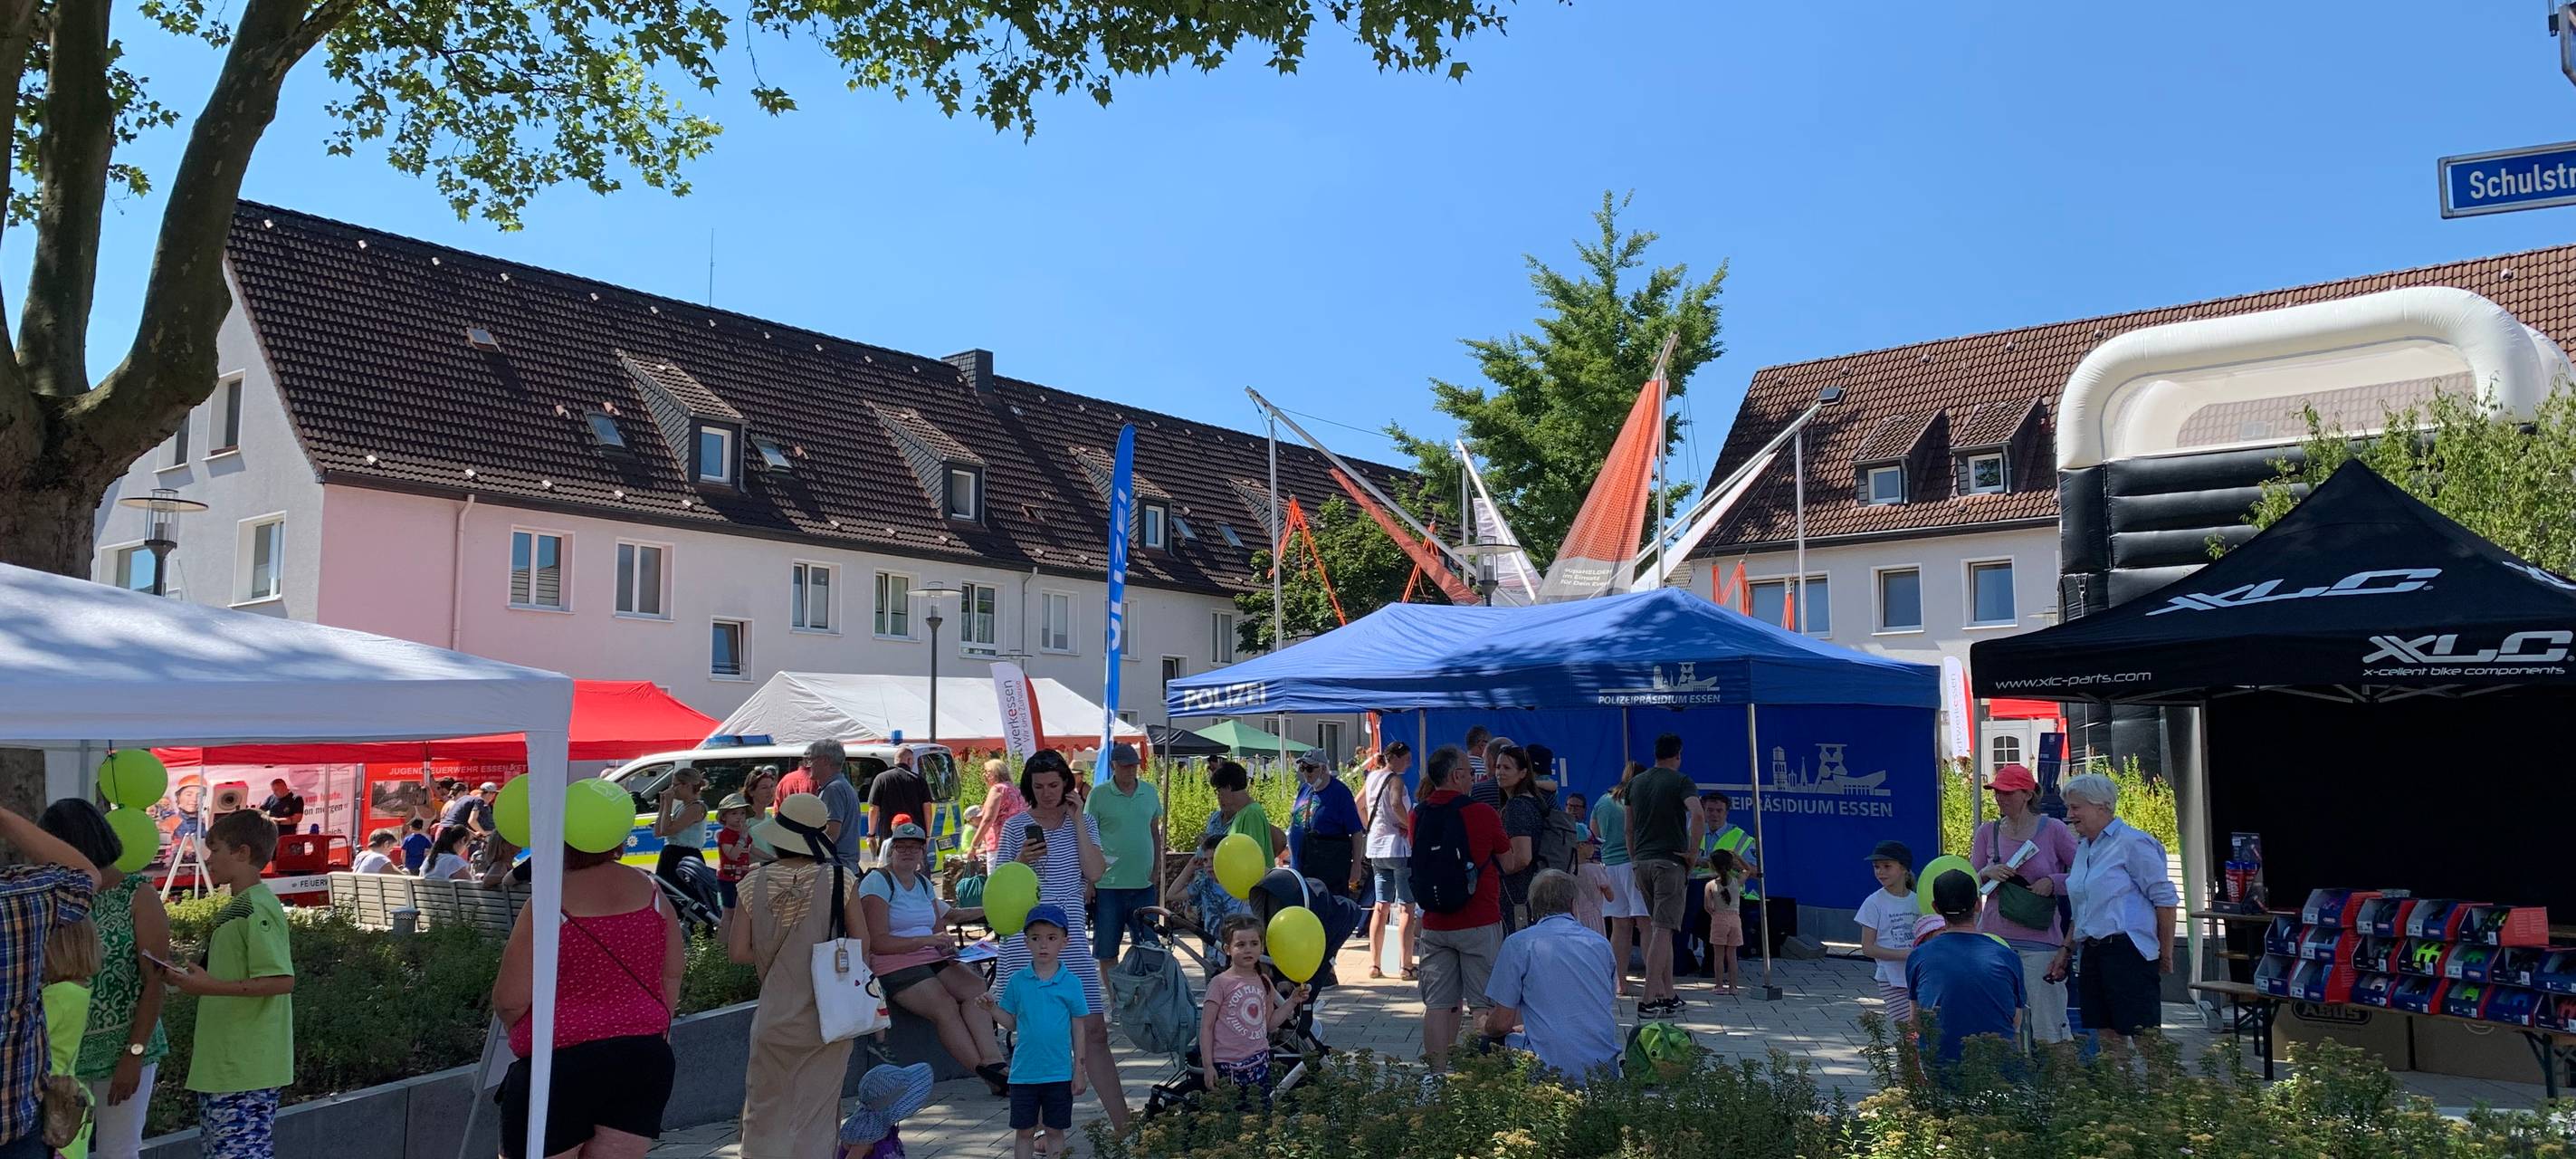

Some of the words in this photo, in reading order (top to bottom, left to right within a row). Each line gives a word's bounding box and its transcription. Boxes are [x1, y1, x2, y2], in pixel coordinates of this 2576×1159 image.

[2470, 164, 2576, 199] Schulstr
[2145, 568, 2443, 616] XLC
[2362, 630, 2574, 664] XLC
[1995, 672, 2151, 689] www.xlc-parts.com
[2430, 666, 2462, 676] bike
[2464, 666, 2566, 677] components
[1184, 683, 1265, 710] POLIZEI
[1598, 693, 1687, 704] POLIZEIPRÄSIDIUM
[1689, 694, 1721, 704] ESSEN
[1838, 800, 1894, 818] ESSEN
